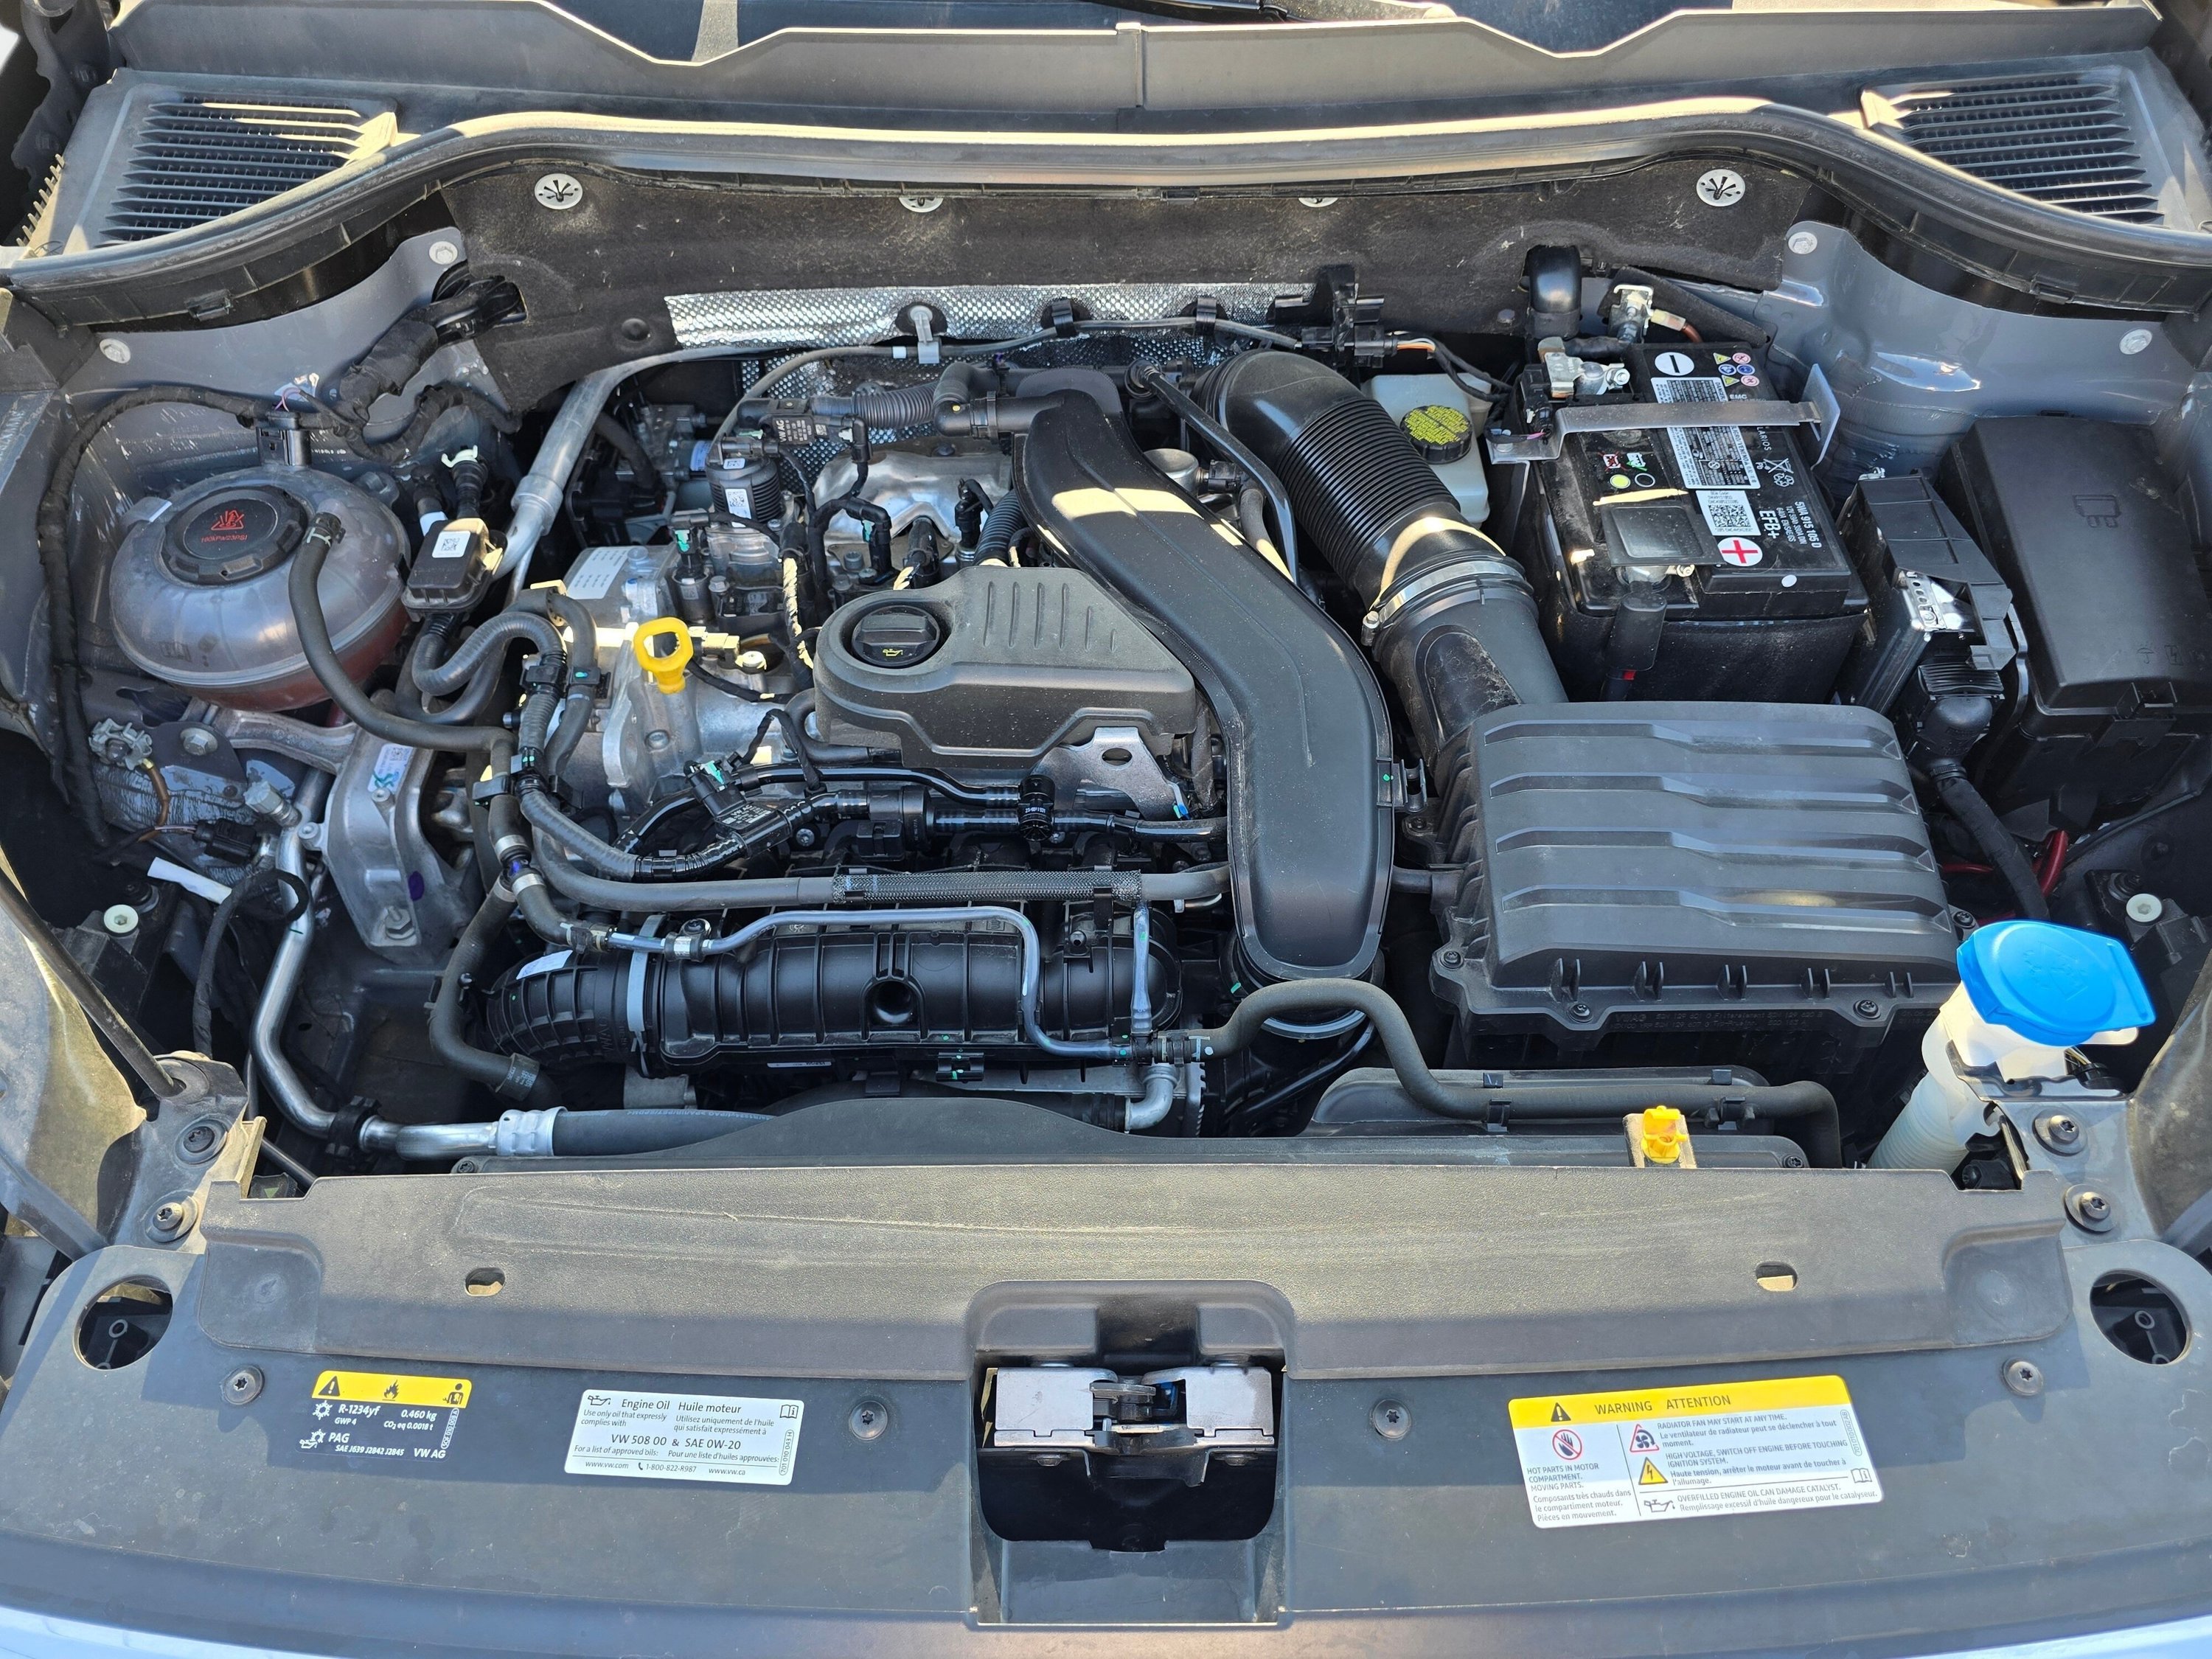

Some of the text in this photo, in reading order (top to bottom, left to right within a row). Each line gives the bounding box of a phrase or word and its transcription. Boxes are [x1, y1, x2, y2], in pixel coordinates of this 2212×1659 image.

[1756, 427, 1772, 451] LARIOS
[1795, 501, 1809, 516] 5WA
[1759, 510, 1781, 539] EFB+
[1801, 516, 1814, 529] 915
[1806, 529, 1820, 542] 105
[621, 1399, 669, 1411] Engine Oil
[678, 1401, 741, 1413] Huile moteur
[1594, 1394, 1731, 1414] WARNING ATTENTION
[338, 1403, 380, 1418] R-1234yf
[400, 1409, 437, 1422] 0.460 kg
[597, 1410, 611, 1419] only
[636, 1413, 667, 1422] expressly
[334, 1416, 351, 1425] GWP
[397, 1422, 406, 1430] eq
[406, 1422, 428, 1430] 0.0018
[580, 1418, 610, 1426] complies
[701, 1416, 742, 1426] uniquement
[1657, 1420, 1691, 1429] RADIATOR
[1750, 1425, 1767, 1433] peut
[1777, 1421, 1814, 1430] déclencher
[328, 1432, 349, 1443] PAG
[611, 1433, 630, 1443] VW
[631, 1435, 650, 1444] 508
[653, 1436, 667, 1445] 00
[684, 1438, 704, 1447] SAE
[706, 1439, 740, 1450] 0W-20
[1848, 1432, 1857, 1442] 010
[1662, 1439, 1693, 1447] moment.
[1683, 1450, 1715, 1458] VOLTAGE,
[1716, 1447, 1742, 1455] SWITCH
[1758, 1444, 1784, 1453] ENGINE
[1784, 1442, 1811, 1450] BEFORE
[1812, 1439, 1847, 1448] TOUCHING
[1852, 1444, 1860, 1453] 701
[364, 1446, 384, 1454] J2842
[384, 1447, 404, 1455] J2845
[414, 1447, 445, 1458] VW AG
[698, 1450, 712, 1458] liste
[712, 1452, 737, 1460] d'huiles
[1573, 1462, 1599, 1470] MOTOR
[1667, 1457, 1728, 1467] IGNITION SYSTEM.
[1813, 1458, 1840, 1467] toucher
[1528, 1472, 1582, 1483] COMPARTMENT.
[1672, 1478, 1711, 1486] l'allumage.
[1530, 1483, 1559, 1491] MOVING
[1677, 1492, 1719, 1502] OVERFILLED
[1720, 1490, 1746, 1498] ENGINE
[1775, 1486, 1805, 1495] DAMAGE
[1806, 1483, 1840, 1492] CATALYST.
[1533, 1494, 1575, 1503] Composants
[1590, 1490, 1613, 1498] chauds
[1679, 1502, 1723, 1512] Remplissage
[1725, 1499, 1751, 1508] excessif
[1753, 1498, 1776, 1506] d'huile
[1778, 1496, 1814, 1504] dangereux
[1815, 1495, 1830, 1503] pour
[1840, 1491, 1877, 1499] catalyseur.
[1543, 1502, 1593, 1512] compartiment
[1537, 1513, 1559, 1521] Pièces
[1571, 1509, 1616, 1518] mouvement.
